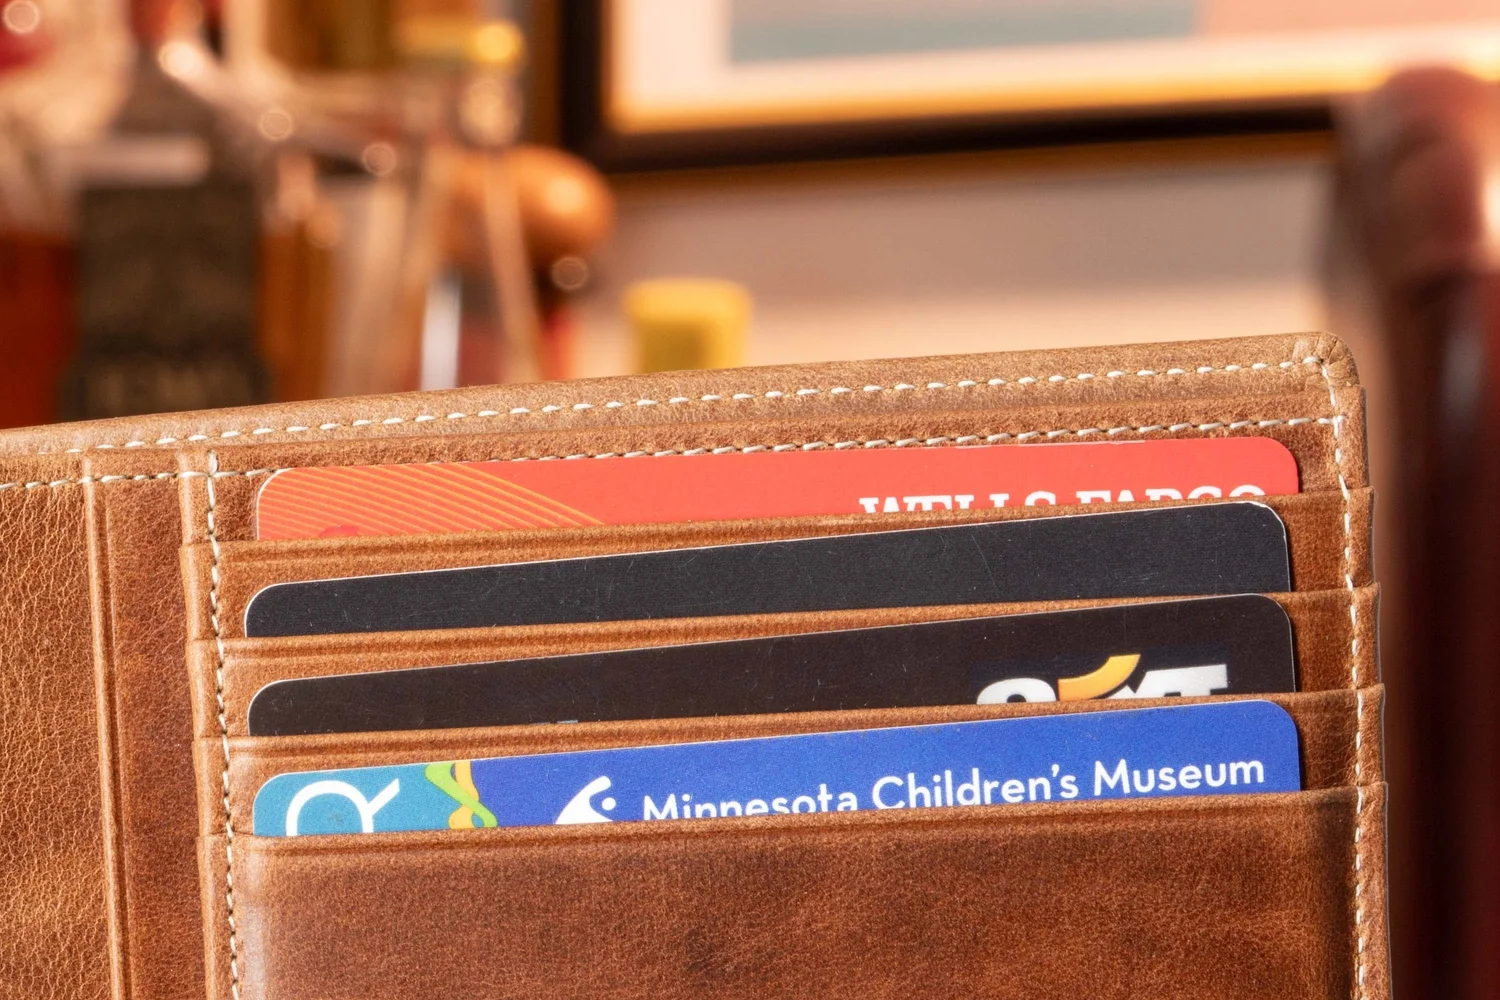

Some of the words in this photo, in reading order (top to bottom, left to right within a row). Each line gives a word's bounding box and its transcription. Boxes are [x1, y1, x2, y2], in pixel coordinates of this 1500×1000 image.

[643, 783, 859, 821] Minnesota
[871, 763, 1080, 810] Children's
[1093, 758, 1265, 797] Museum
